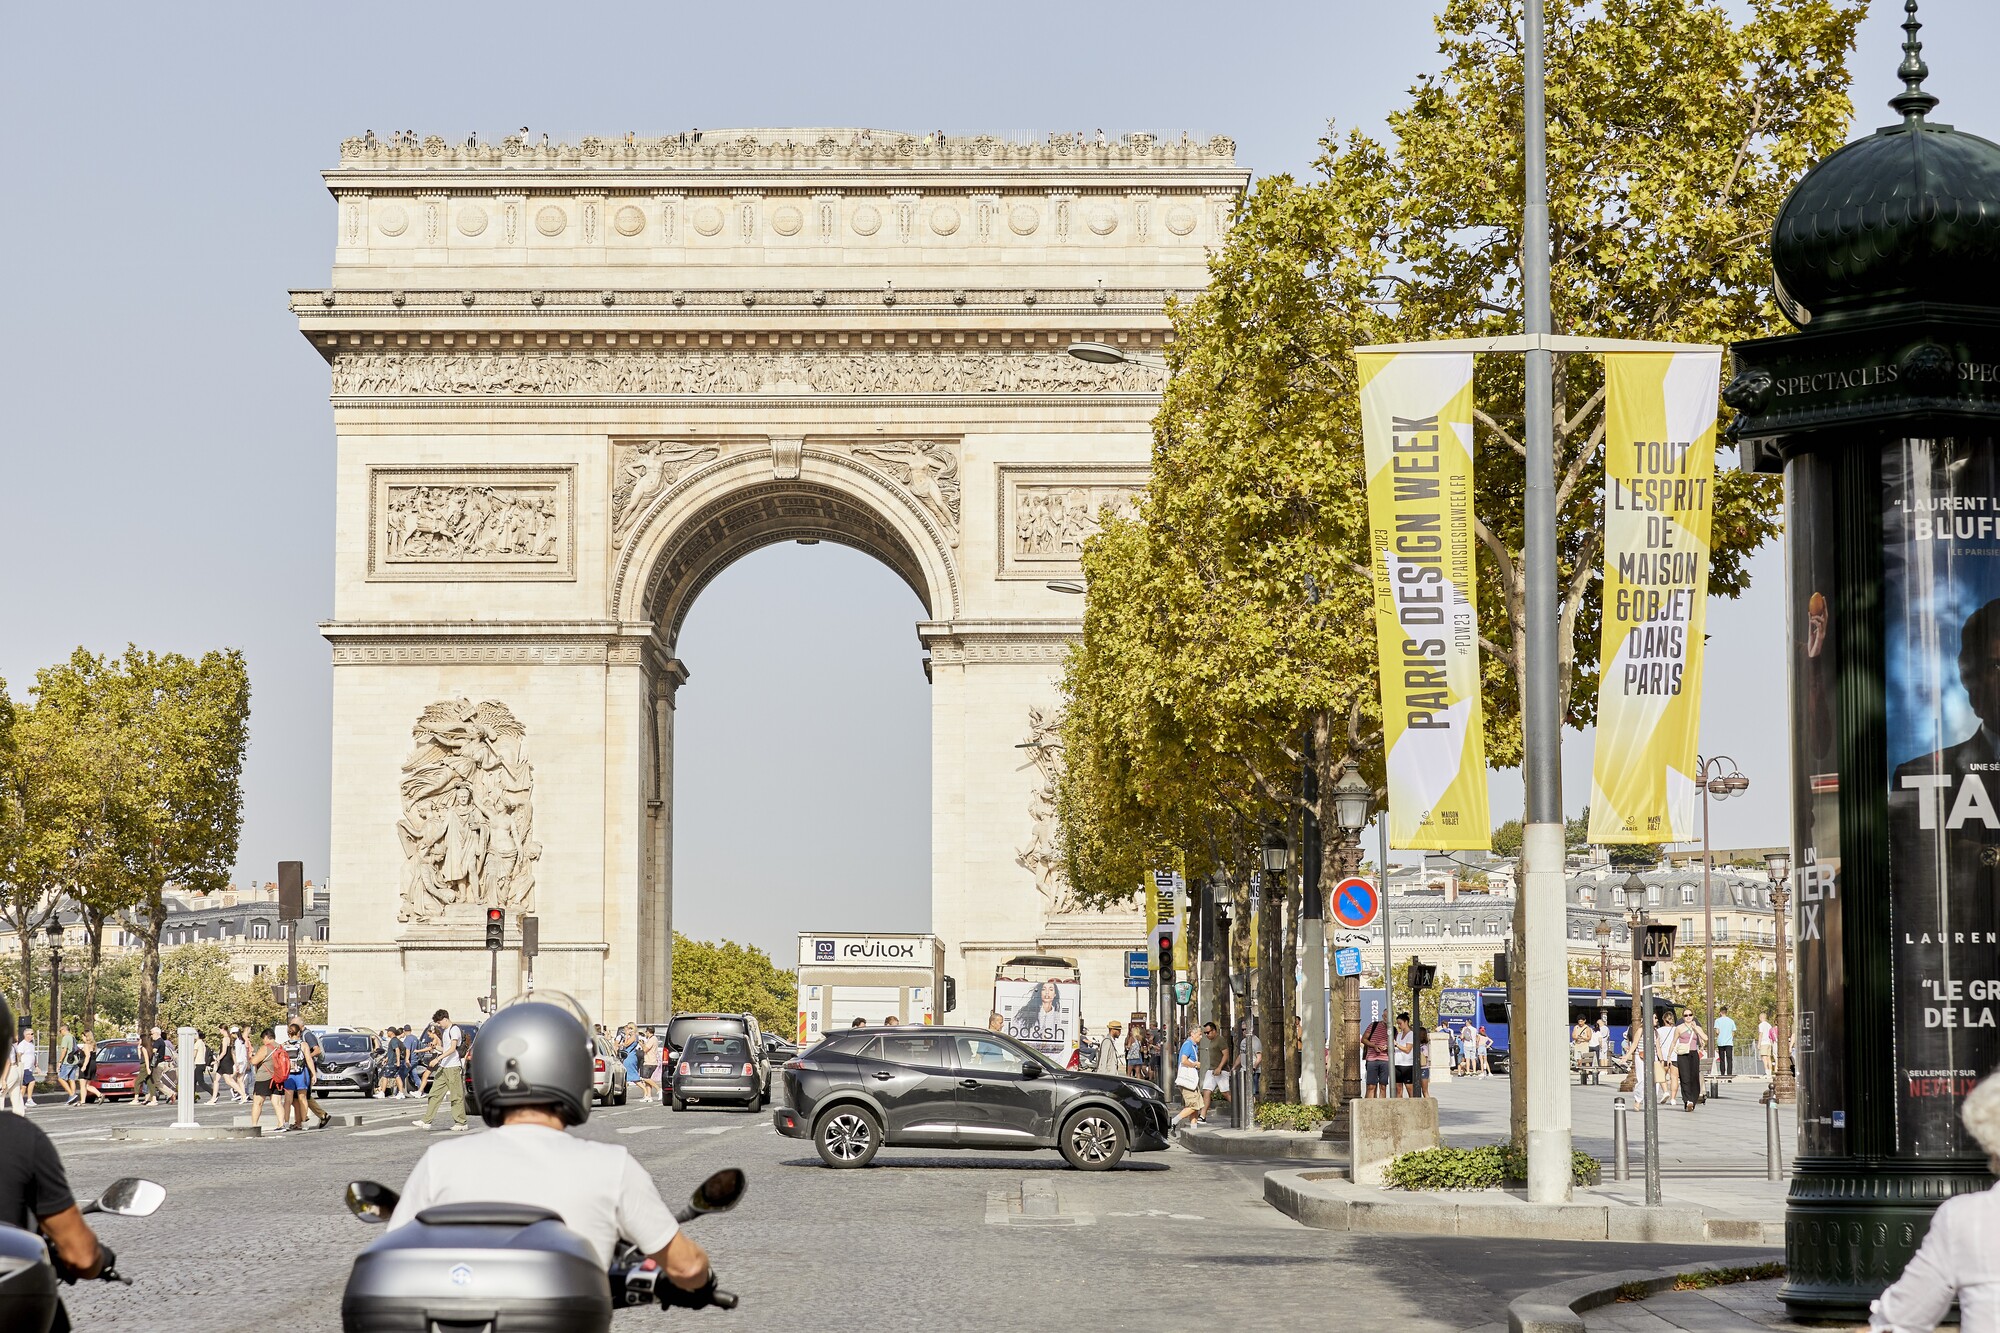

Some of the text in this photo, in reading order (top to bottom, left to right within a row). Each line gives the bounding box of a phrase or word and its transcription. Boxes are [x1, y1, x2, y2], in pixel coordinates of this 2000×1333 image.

[1775, 364, 1898, 397] SPECTACLES
[1634, 442, 1690, 475] TOUT
[1615, 478, 1707, 512] L'ESPRIT
[1374, 528, 1389, 552] 2023
[1646, 516, 1674, 549] DE
[1377, 556, 1390, 584] SEPT.
[1391, 415, 1450, 729] PARIS DESIGN WEEK
[1449, 474, 1471, 656] #PDW23 WWW.PARISDESIGNWEEK.FR
[1618, 551, 1699, 586] MAISON
[1616, 588, 1696, 622] &OBJET
[1628, 625, 1683, 660] DANS
[1623, 662, 1683, 696] PARIS
[1970, 763, 1988, 771] UNE
[1901, 774, 2000, 829] TA
[1804, 847, 1817, 865] UN
[1157, 890, 1175, 926] PARIS
[843, 941, 914, 958] revilox
[1905, 932, 1996, 944] LAUREN
[1924, 1007, 1996, 1028] DE LA
[1909, 1069, 1976, 1077] SEULEMENT SUR
[1909, 1078, 1977, 1098] NETFLIX
